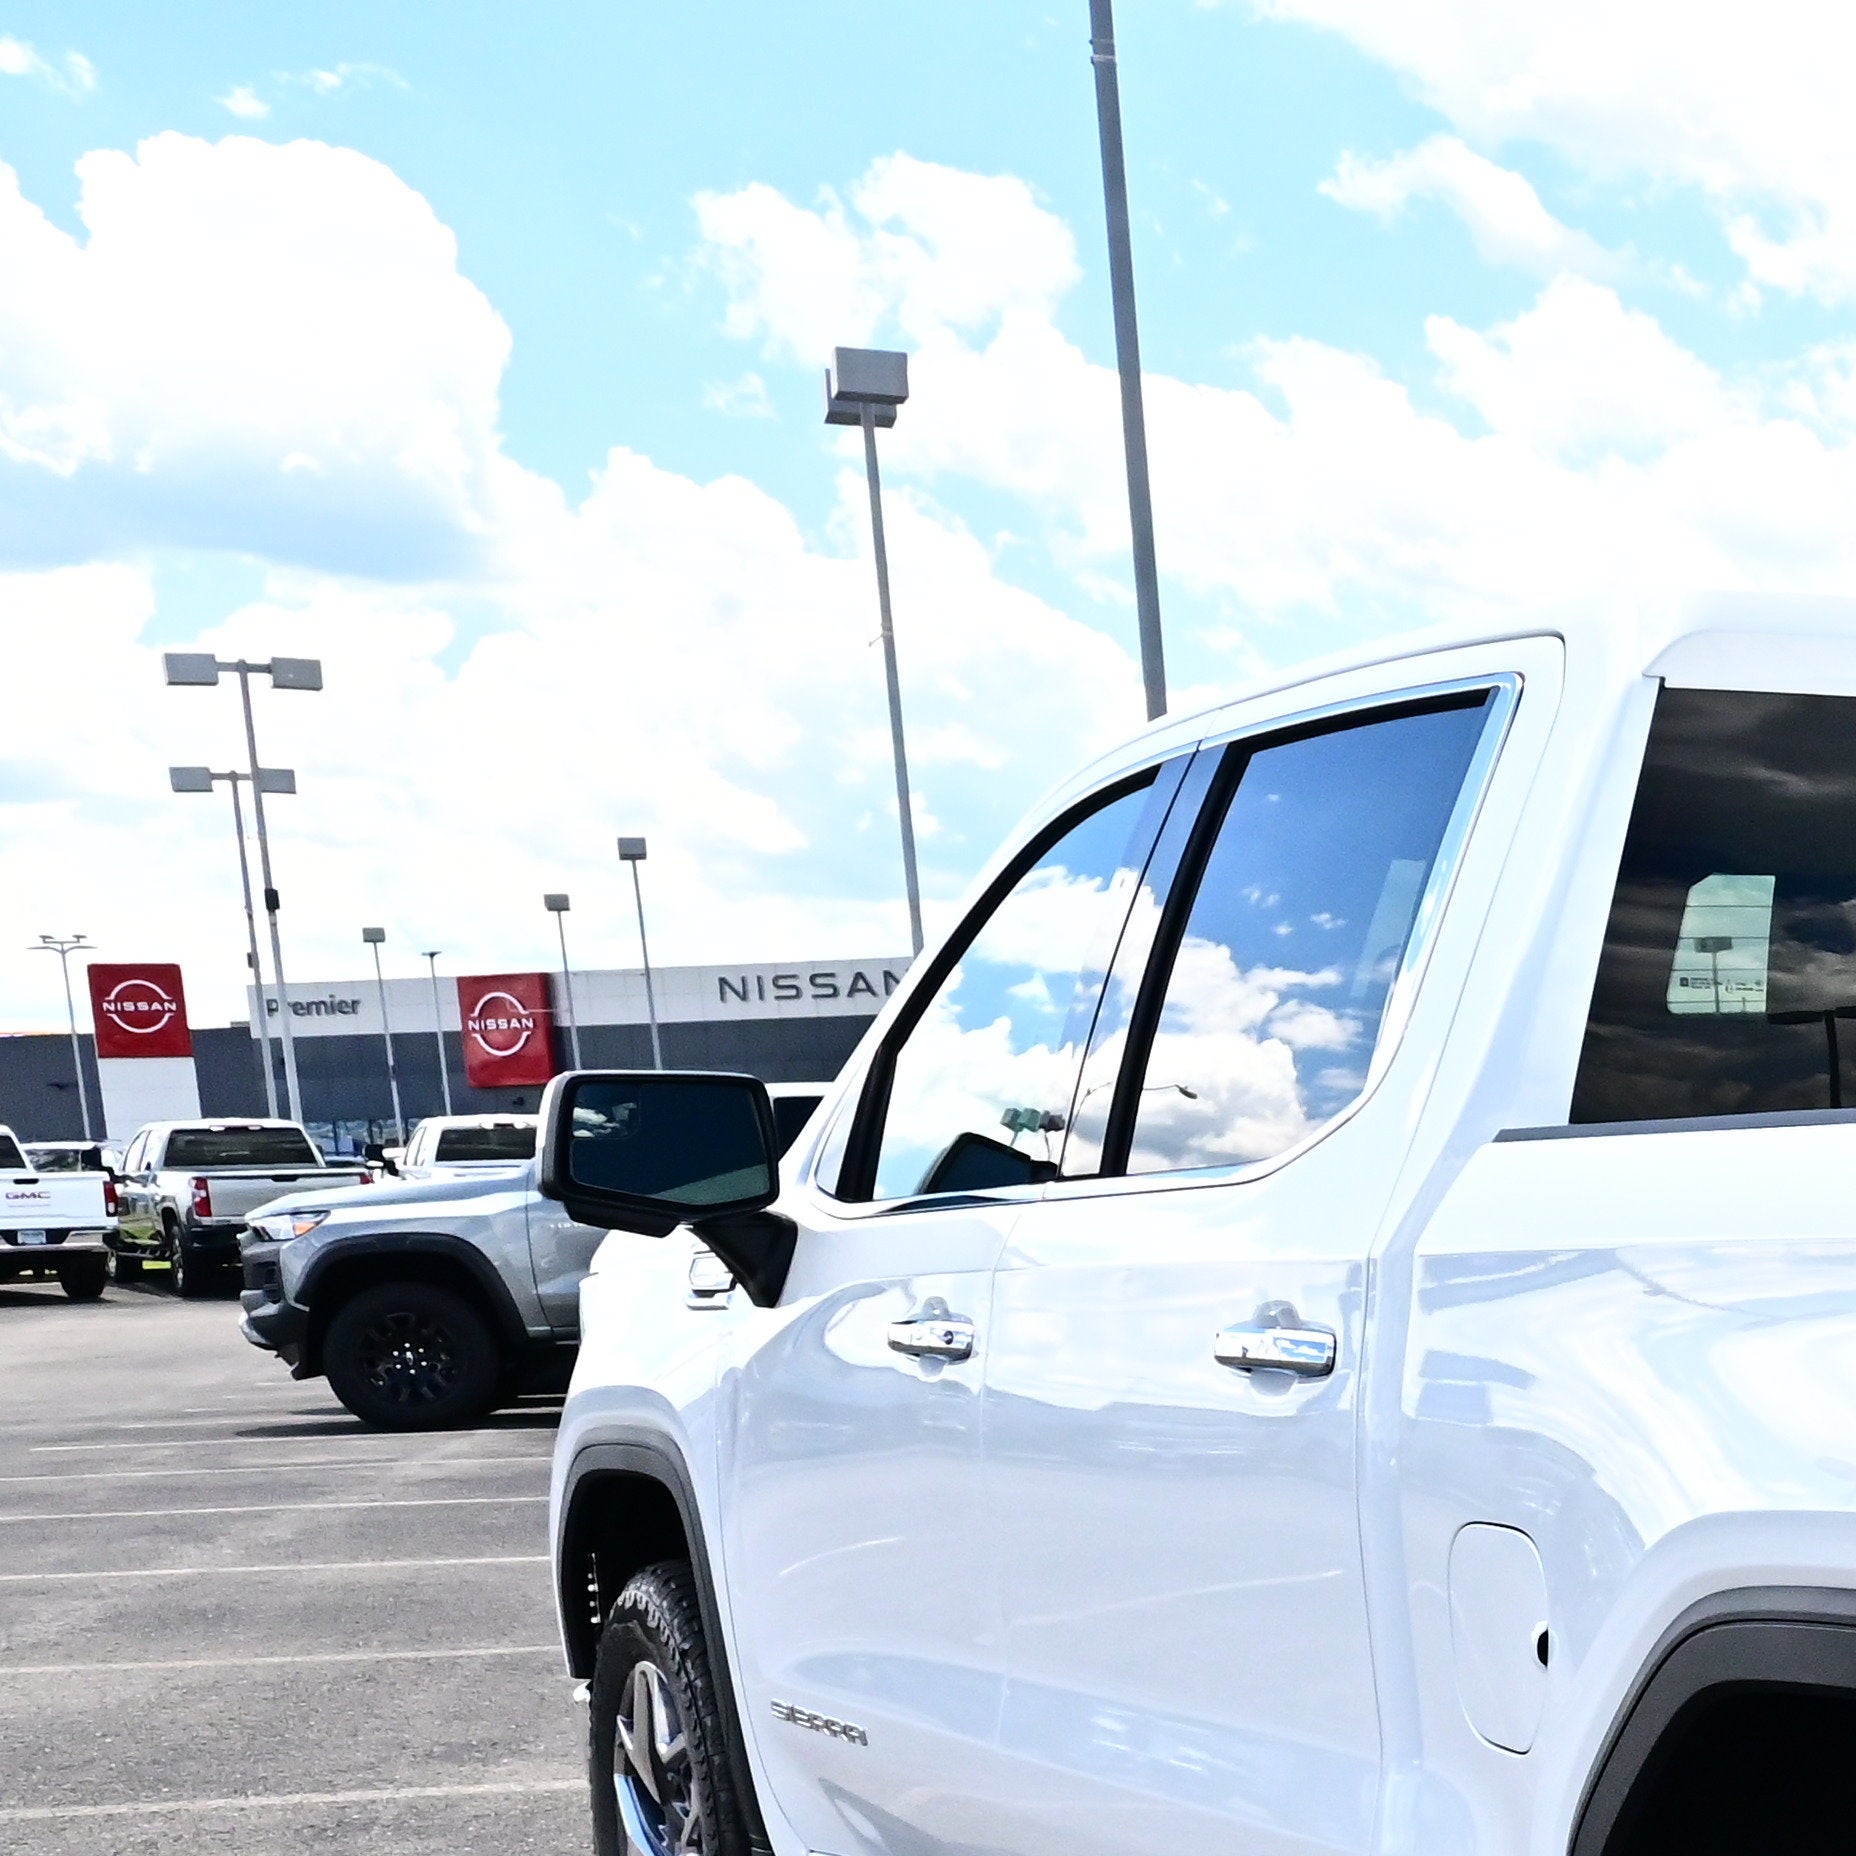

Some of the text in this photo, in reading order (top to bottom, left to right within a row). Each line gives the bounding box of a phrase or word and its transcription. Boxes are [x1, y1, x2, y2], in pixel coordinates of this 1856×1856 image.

[102, 1001, 177, 1012] NISSAN
[265, 993, 361, 1017] Pemier
[468, 1016, 535, 1031] NISSAN
[5, 1190, 52, 1200] GMC
